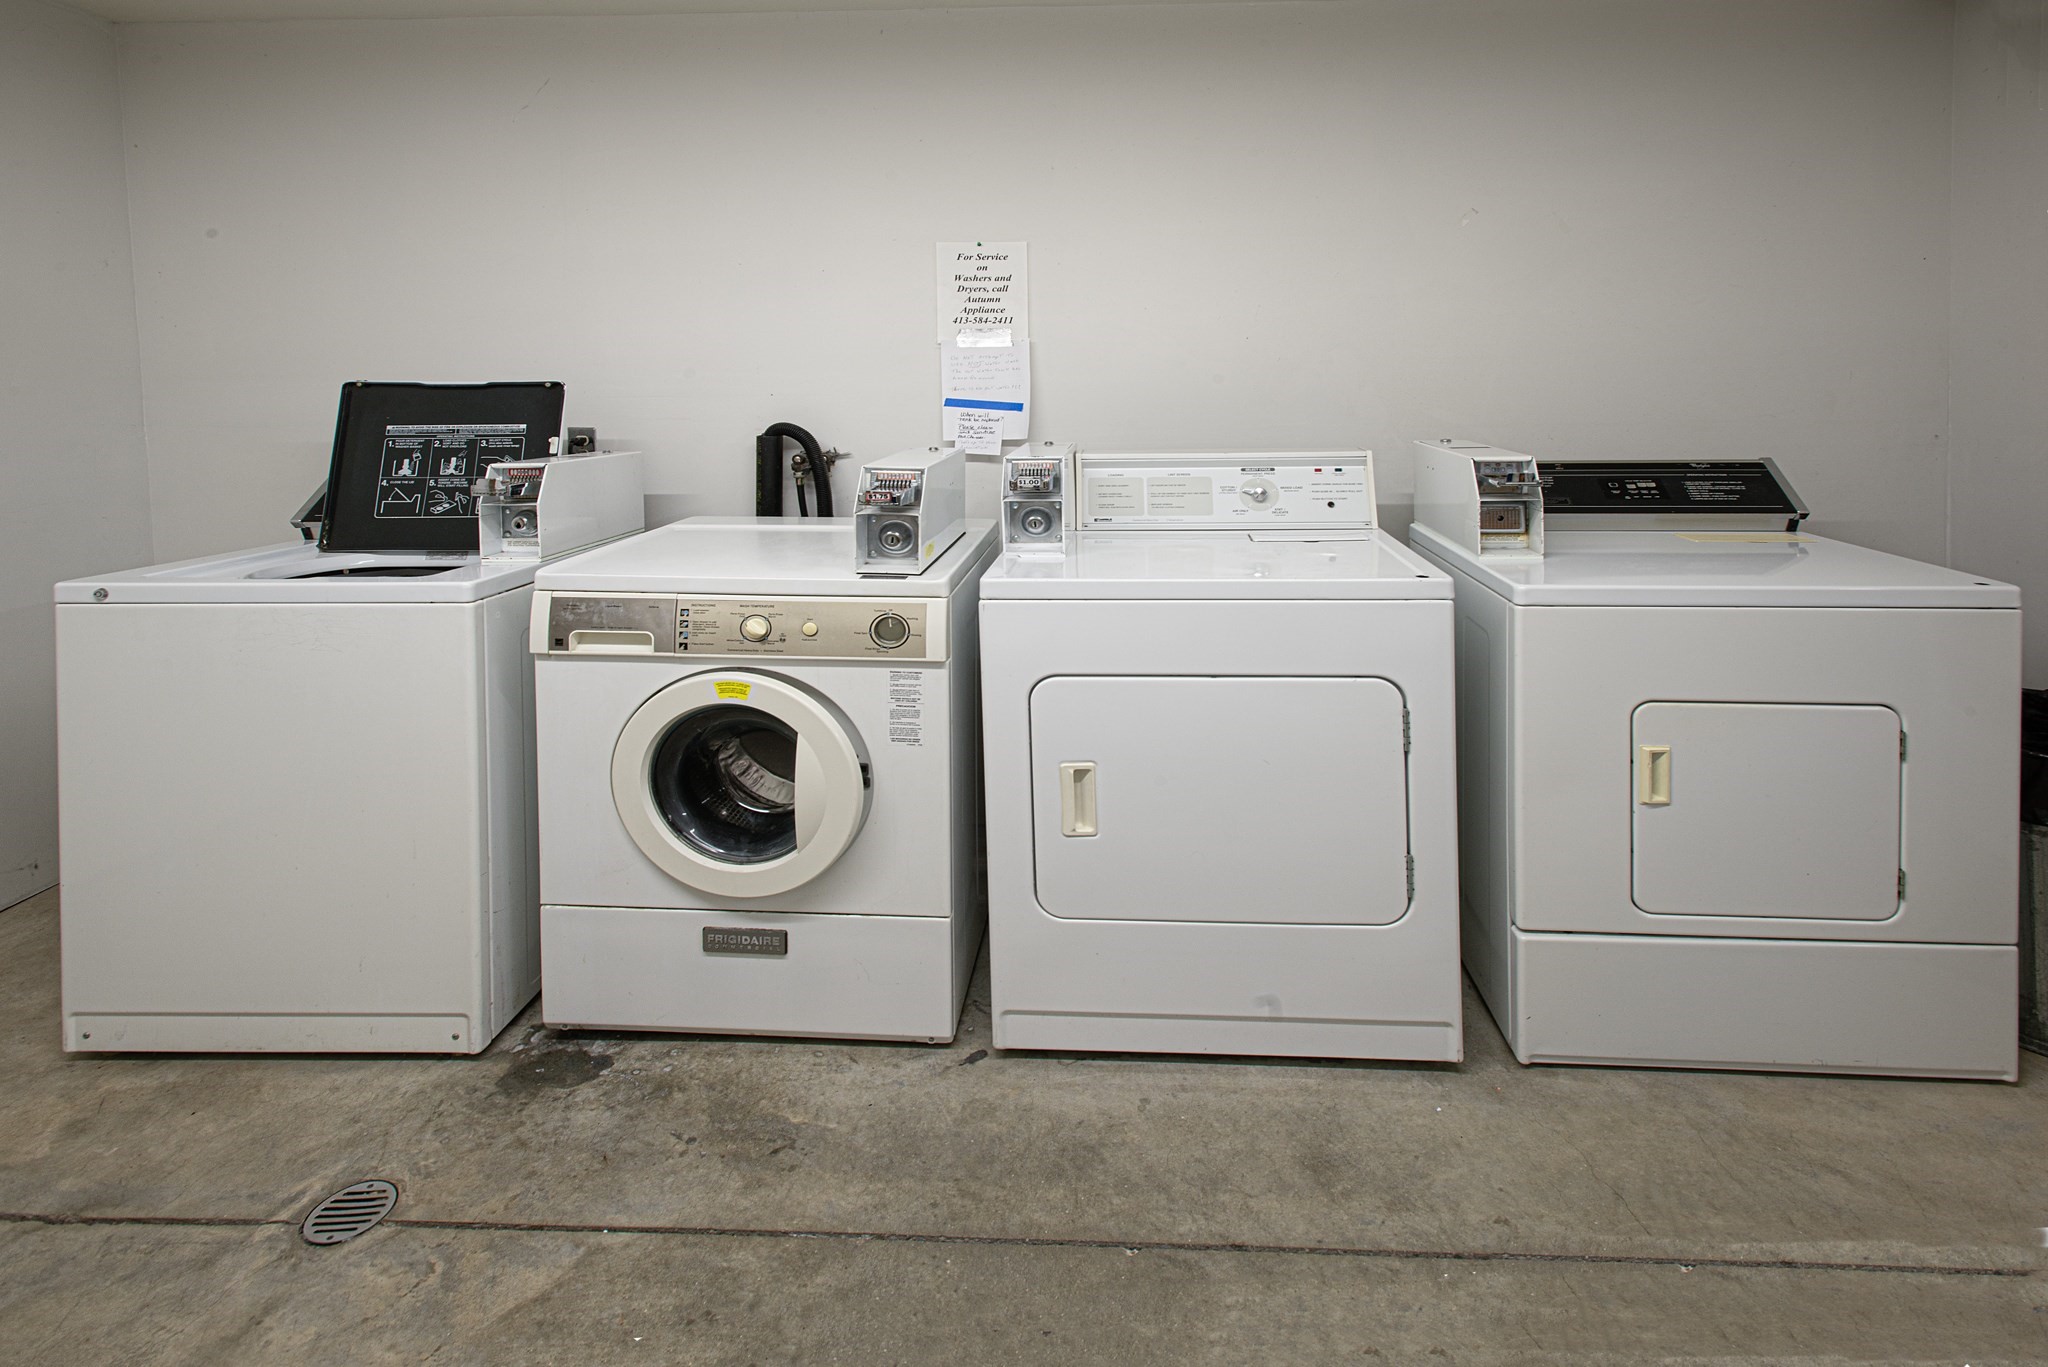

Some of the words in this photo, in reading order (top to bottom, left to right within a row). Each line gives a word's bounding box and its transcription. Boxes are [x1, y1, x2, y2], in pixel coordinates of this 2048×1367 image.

[957, 253, 974, 261] For
[975, 253, 1008, 261] Service
[954, 274, 992, 282] Washers
[994, 274, 1012, 282] and
[957, 285, 989, 294] Dryers,
[992, 285, 1009, 293] call
[960, 306, 1006, 315] Appliance
[953, 316, 1013, 324] 413-584-2411
[707, 934, 780, 946] FRIGIDAIRE
